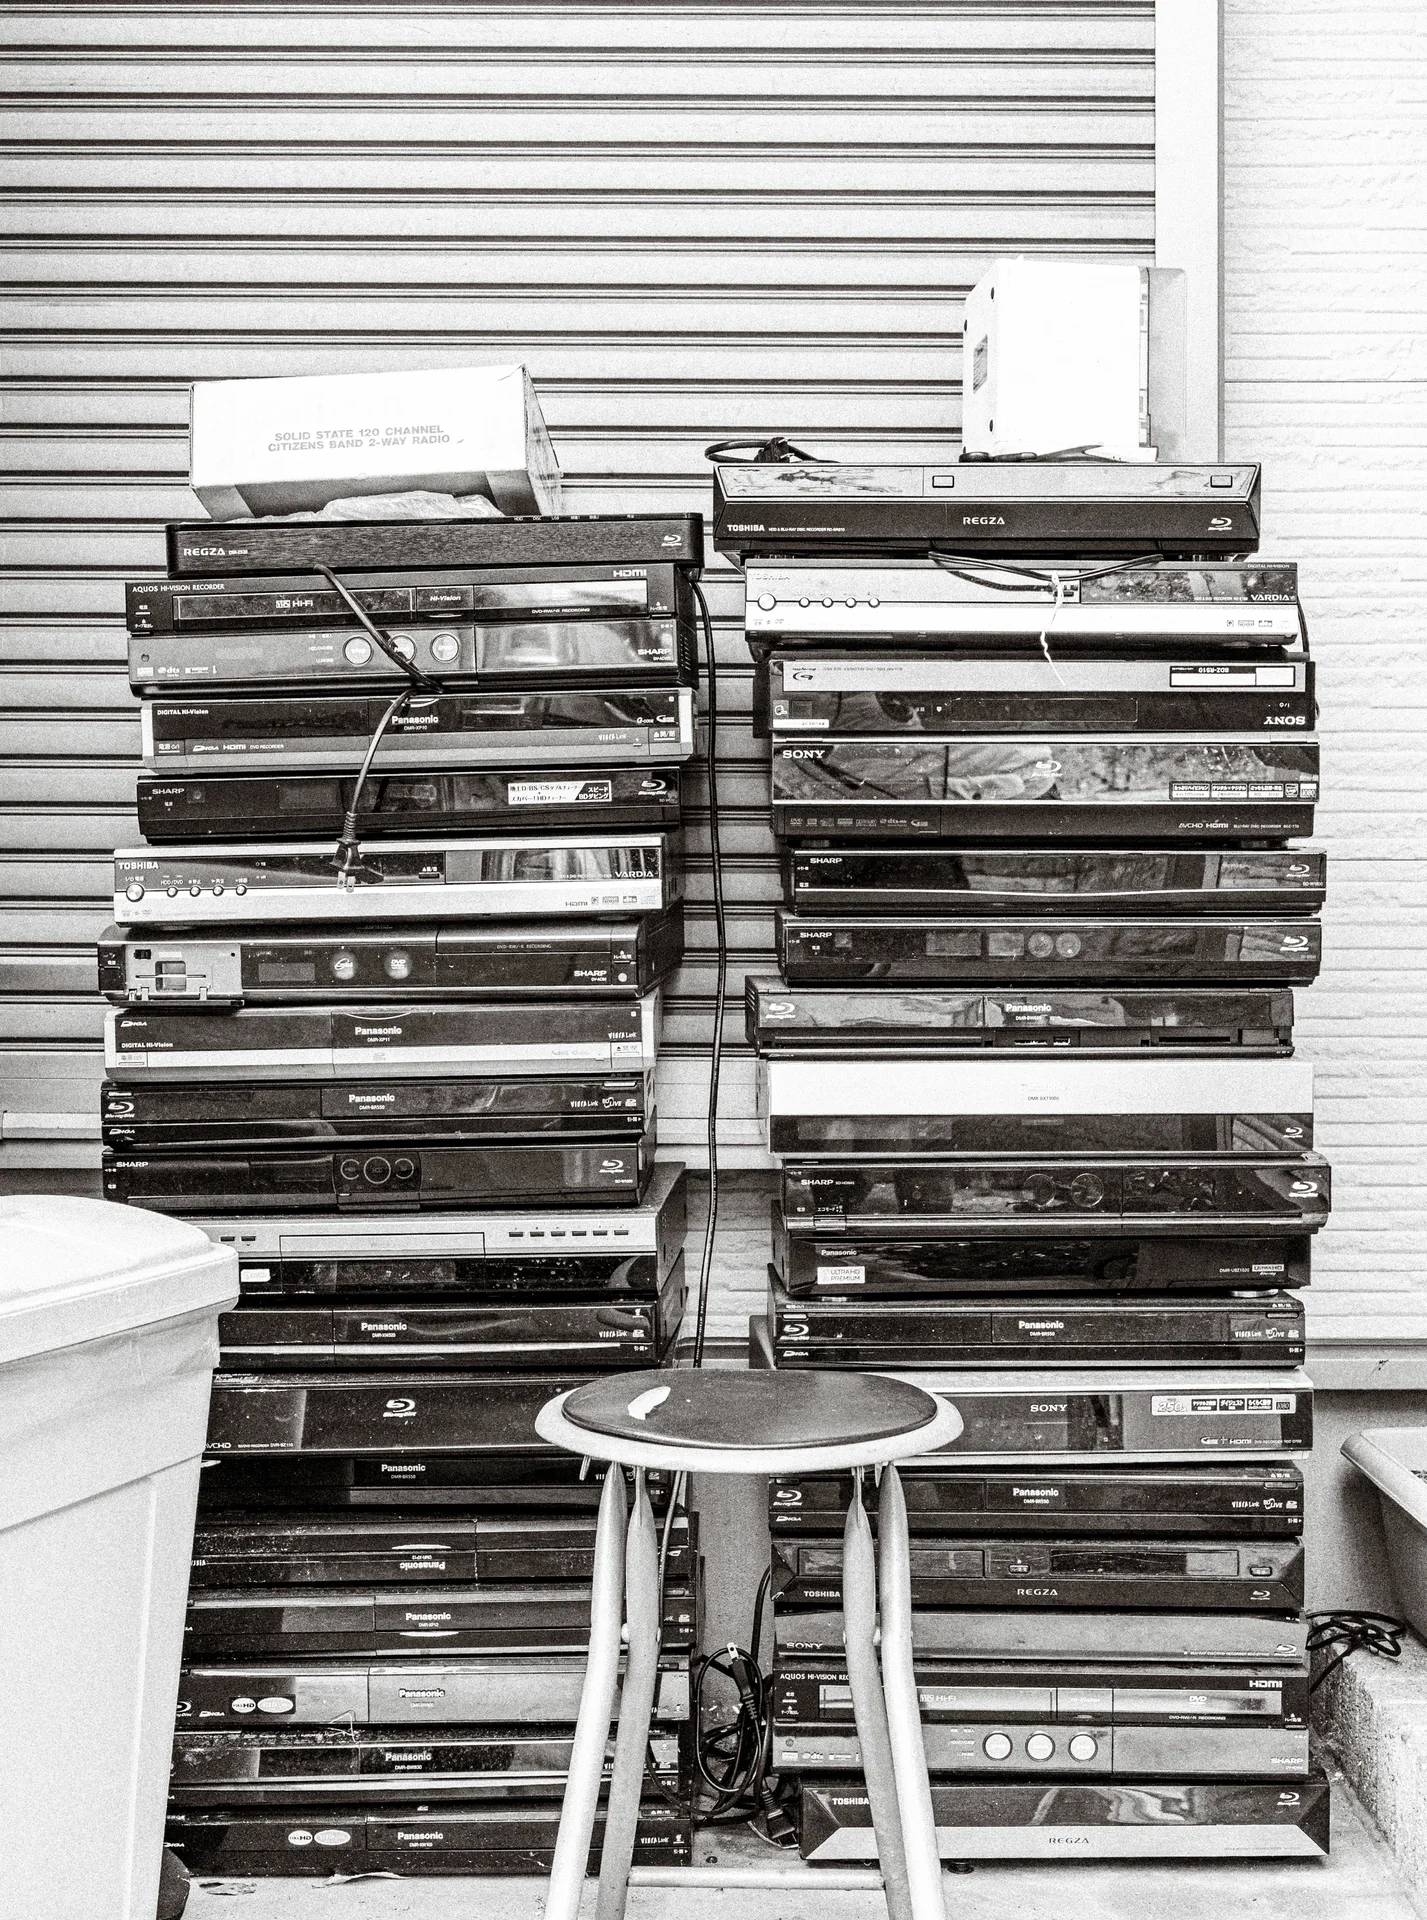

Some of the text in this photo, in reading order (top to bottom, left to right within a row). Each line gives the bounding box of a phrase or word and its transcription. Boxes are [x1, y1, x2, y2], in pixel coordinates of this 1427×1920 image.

[275, 425, 444, 442] SOLID STATE 120 CHANNEL
[268, 434, 450, 452] CITIZENS BAND 2-WAY RADIO
[962, 516, 1005, 525] REGZA
[726, 524, 765, 532] TOSHIBA
[183, 548, 226, 556] REGZA
[613, 569, 647, 578] HDMI
[132, 584, 158, 593] AQUOS
[392, 716, 438, 724] Panasonic
[1264, 716, 1306, 725] SONY
[782, 750, 826, 759] SONY
[118, 862, 159, 870] TOSHIBA
[1006, 1003, 1052, 1012] Panasonic
[354, 1026, 402, 1035] Panasonic
[348, 1094, 395, 1102] Panasonic
[360, 1322, 408, 1331] Panasonic
[1018, 1320, 1064, 1330] Panasonic
[1030, 1404, 1068, 1412] SONY
[381, 1464, 426, 1472] Panasonic
[1012, 1488, 1059, 1497] Panasonic
[400, 1561, 446, 1571] Panasonic
[1017, 1588, 1058, 1596] REGZA
[405, 1612, 452, 1621] Panasonic
[780, 1673, 806, 1682] AQUOS
[1249, 1680, 1282, 1688] HDMI
[399, 1688, 446, 1698] Panasonic
[1188, 1695, 1208, 1703] DVD
[385, 1752, 432, 1762] Panasonic
[832, 1797, 869, 1805] TOSHIBA
[397, 1831, 444, 1840] Panasonic
